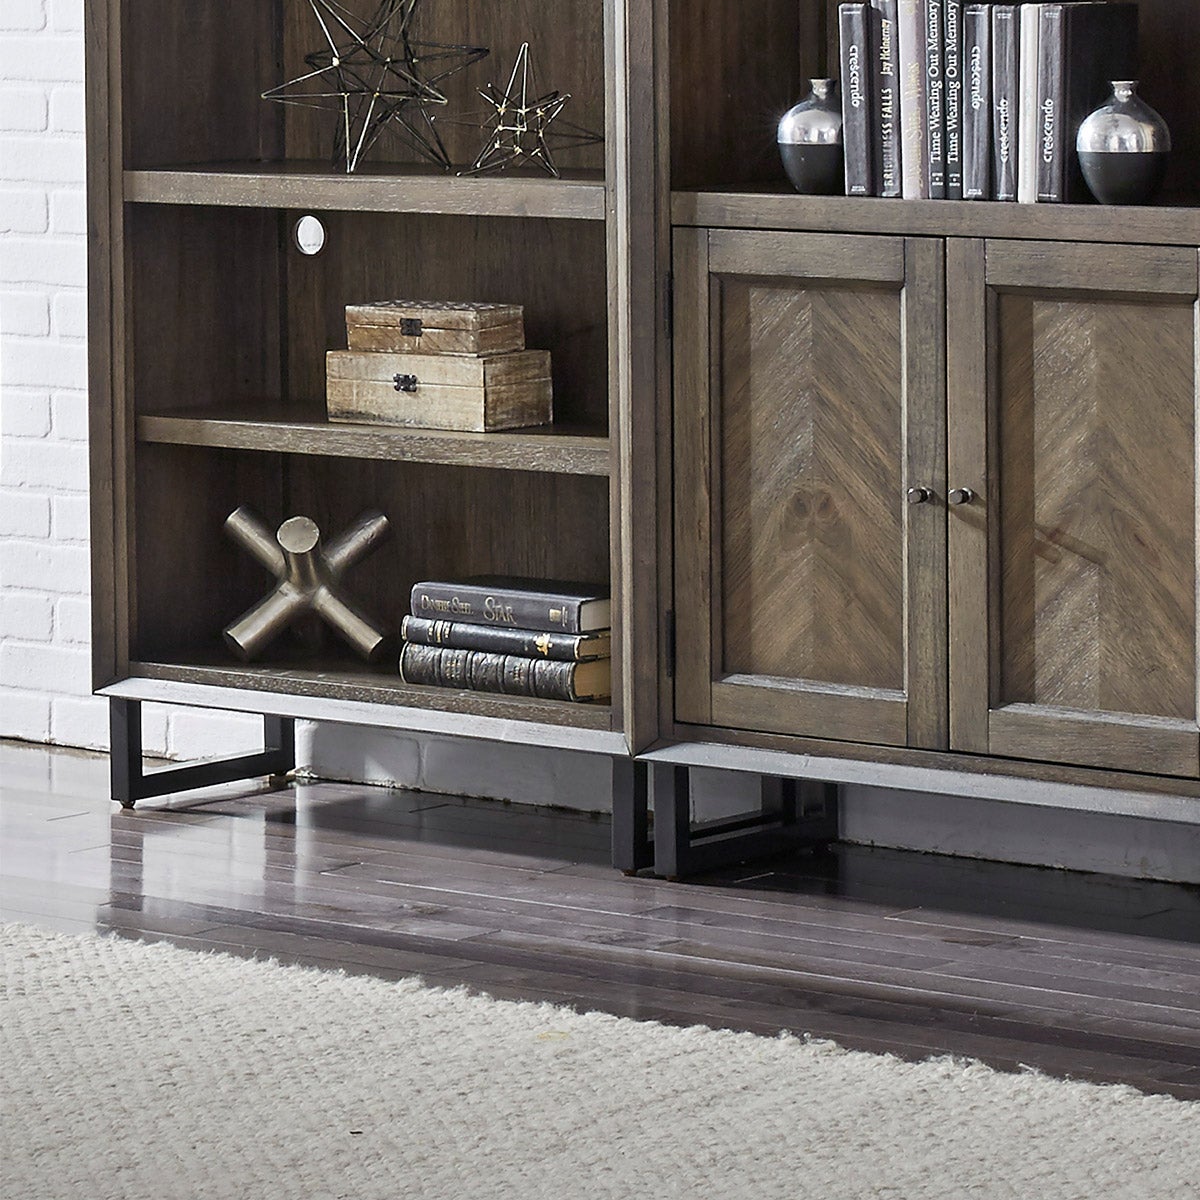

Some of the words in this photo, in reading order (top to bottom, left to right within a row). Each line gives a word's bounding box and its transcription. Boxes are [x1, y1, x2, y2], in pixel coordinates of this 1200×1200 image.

[880, 18, 892, 60] McInerney
[927, 0, 941, 52] Memory
[946, 0, 960, 52] Memory
[849, 44, 865, 108] crescendo
[880, 62, 894, 76] Jay
[928, 54, 939, 78] Out
[946, 54, 958, 78] Out
[971, 46, 984, 110] crescendo
[882, 88, 893, 119] FALLS
[929, 80, 943, 130] Wearing
[946, 80, 960, 131] Wearing
[882, 122, 894, 187] BRIGHTNESS
[930, 132, 941, 164] Time
[947, 132, 958, 164] Time
[996, 97, 1009, 163] crescendo
[1041, 98, 1054, 163] crescendo
